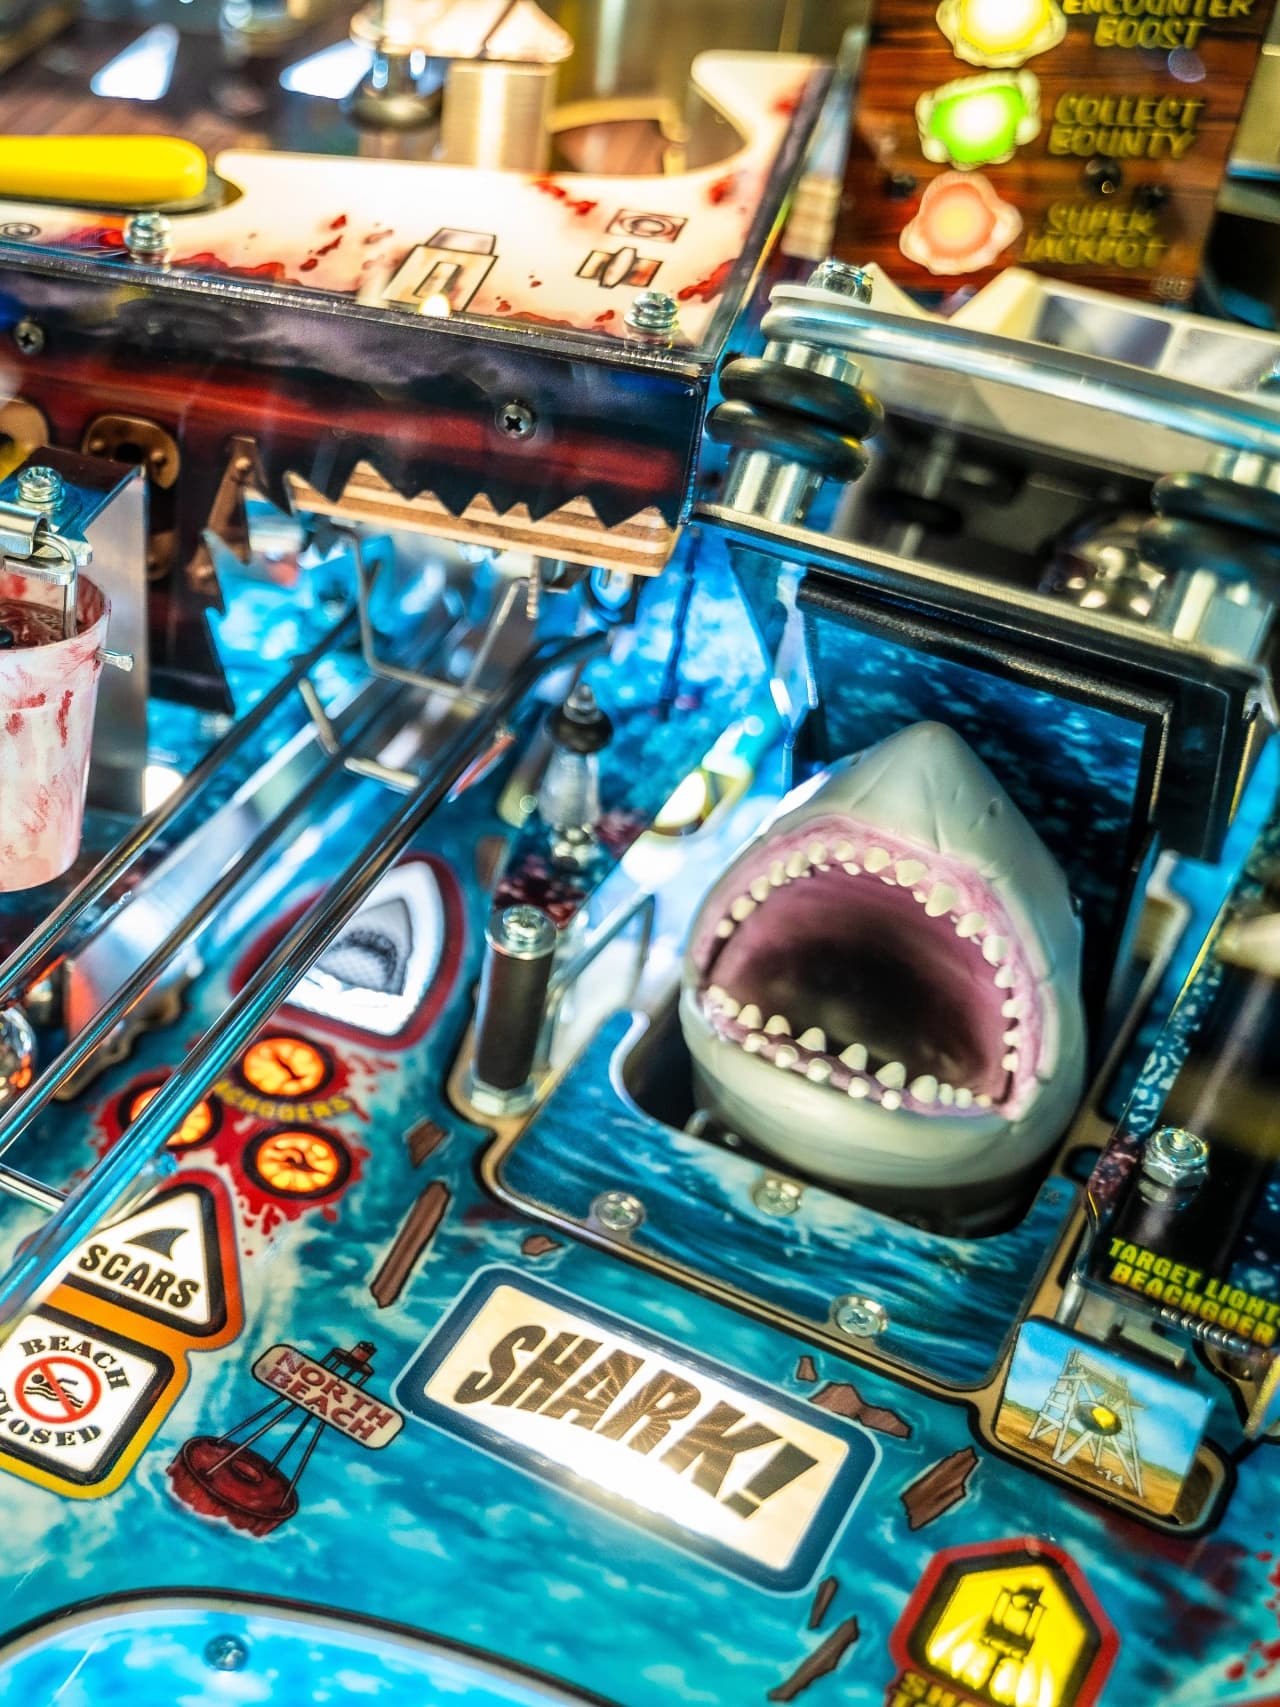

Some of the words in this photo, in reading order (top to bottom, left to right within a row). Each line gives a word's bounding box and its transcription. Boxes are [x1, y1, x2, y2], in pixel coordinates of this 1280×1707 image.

[1094, 13, 1206, 49] BOOST
[1054, 92, 1206, 128] COLLECT
[1048, 122, 1197, 160] BOUNTY
[1048, 201, 1157, 238] SUPER
[1019, 231, 1168, 270] JACKPOT
[78, 1244, 200, 1308] SCARS
[1109, 1238, 1201, 1290] TARGET
[1204, 1277, 1280, 1328] LIGHT
[1110, 1261, 1277, 1347] BEACHGOER
[20, 1335, 130, 1391] BEACH
[276, 1351, 394, 1429] NORTH
[265, 1366, 377, 1441] BEACH
[452, 1323, 820, 1521] SHARK!
